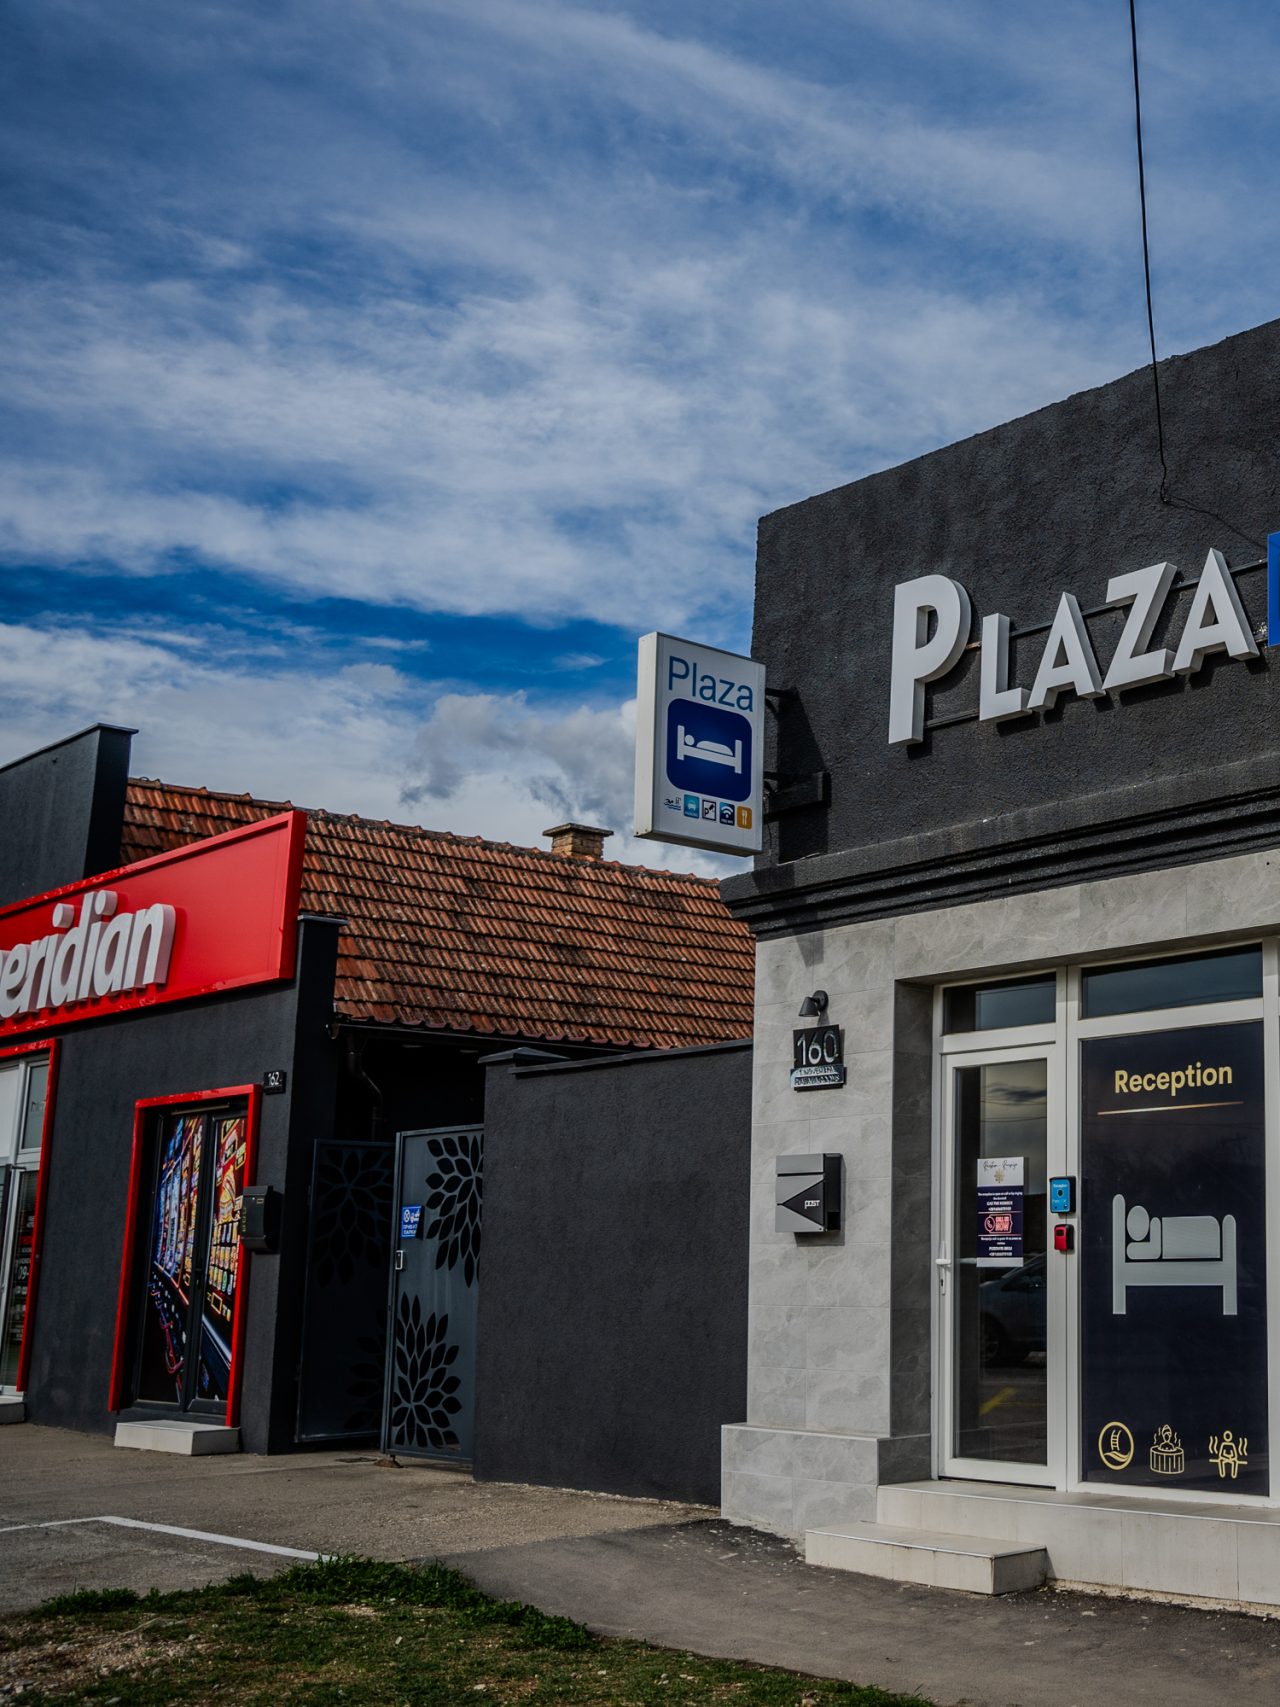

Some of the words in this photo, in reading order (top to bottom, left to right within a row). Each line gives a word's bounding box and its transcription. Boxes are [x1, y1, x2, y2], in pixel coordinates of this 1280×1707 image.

[888, 548, 1260, 746] PLAZA
[668, 656, 754, 712] Plaza
[0, 890, 176, 1018] eridian
[797, 1030, 838, 1066] 160
[267, 1071, 280, 1086] 162
[1114, 1061, 1233, 1096] Reception
